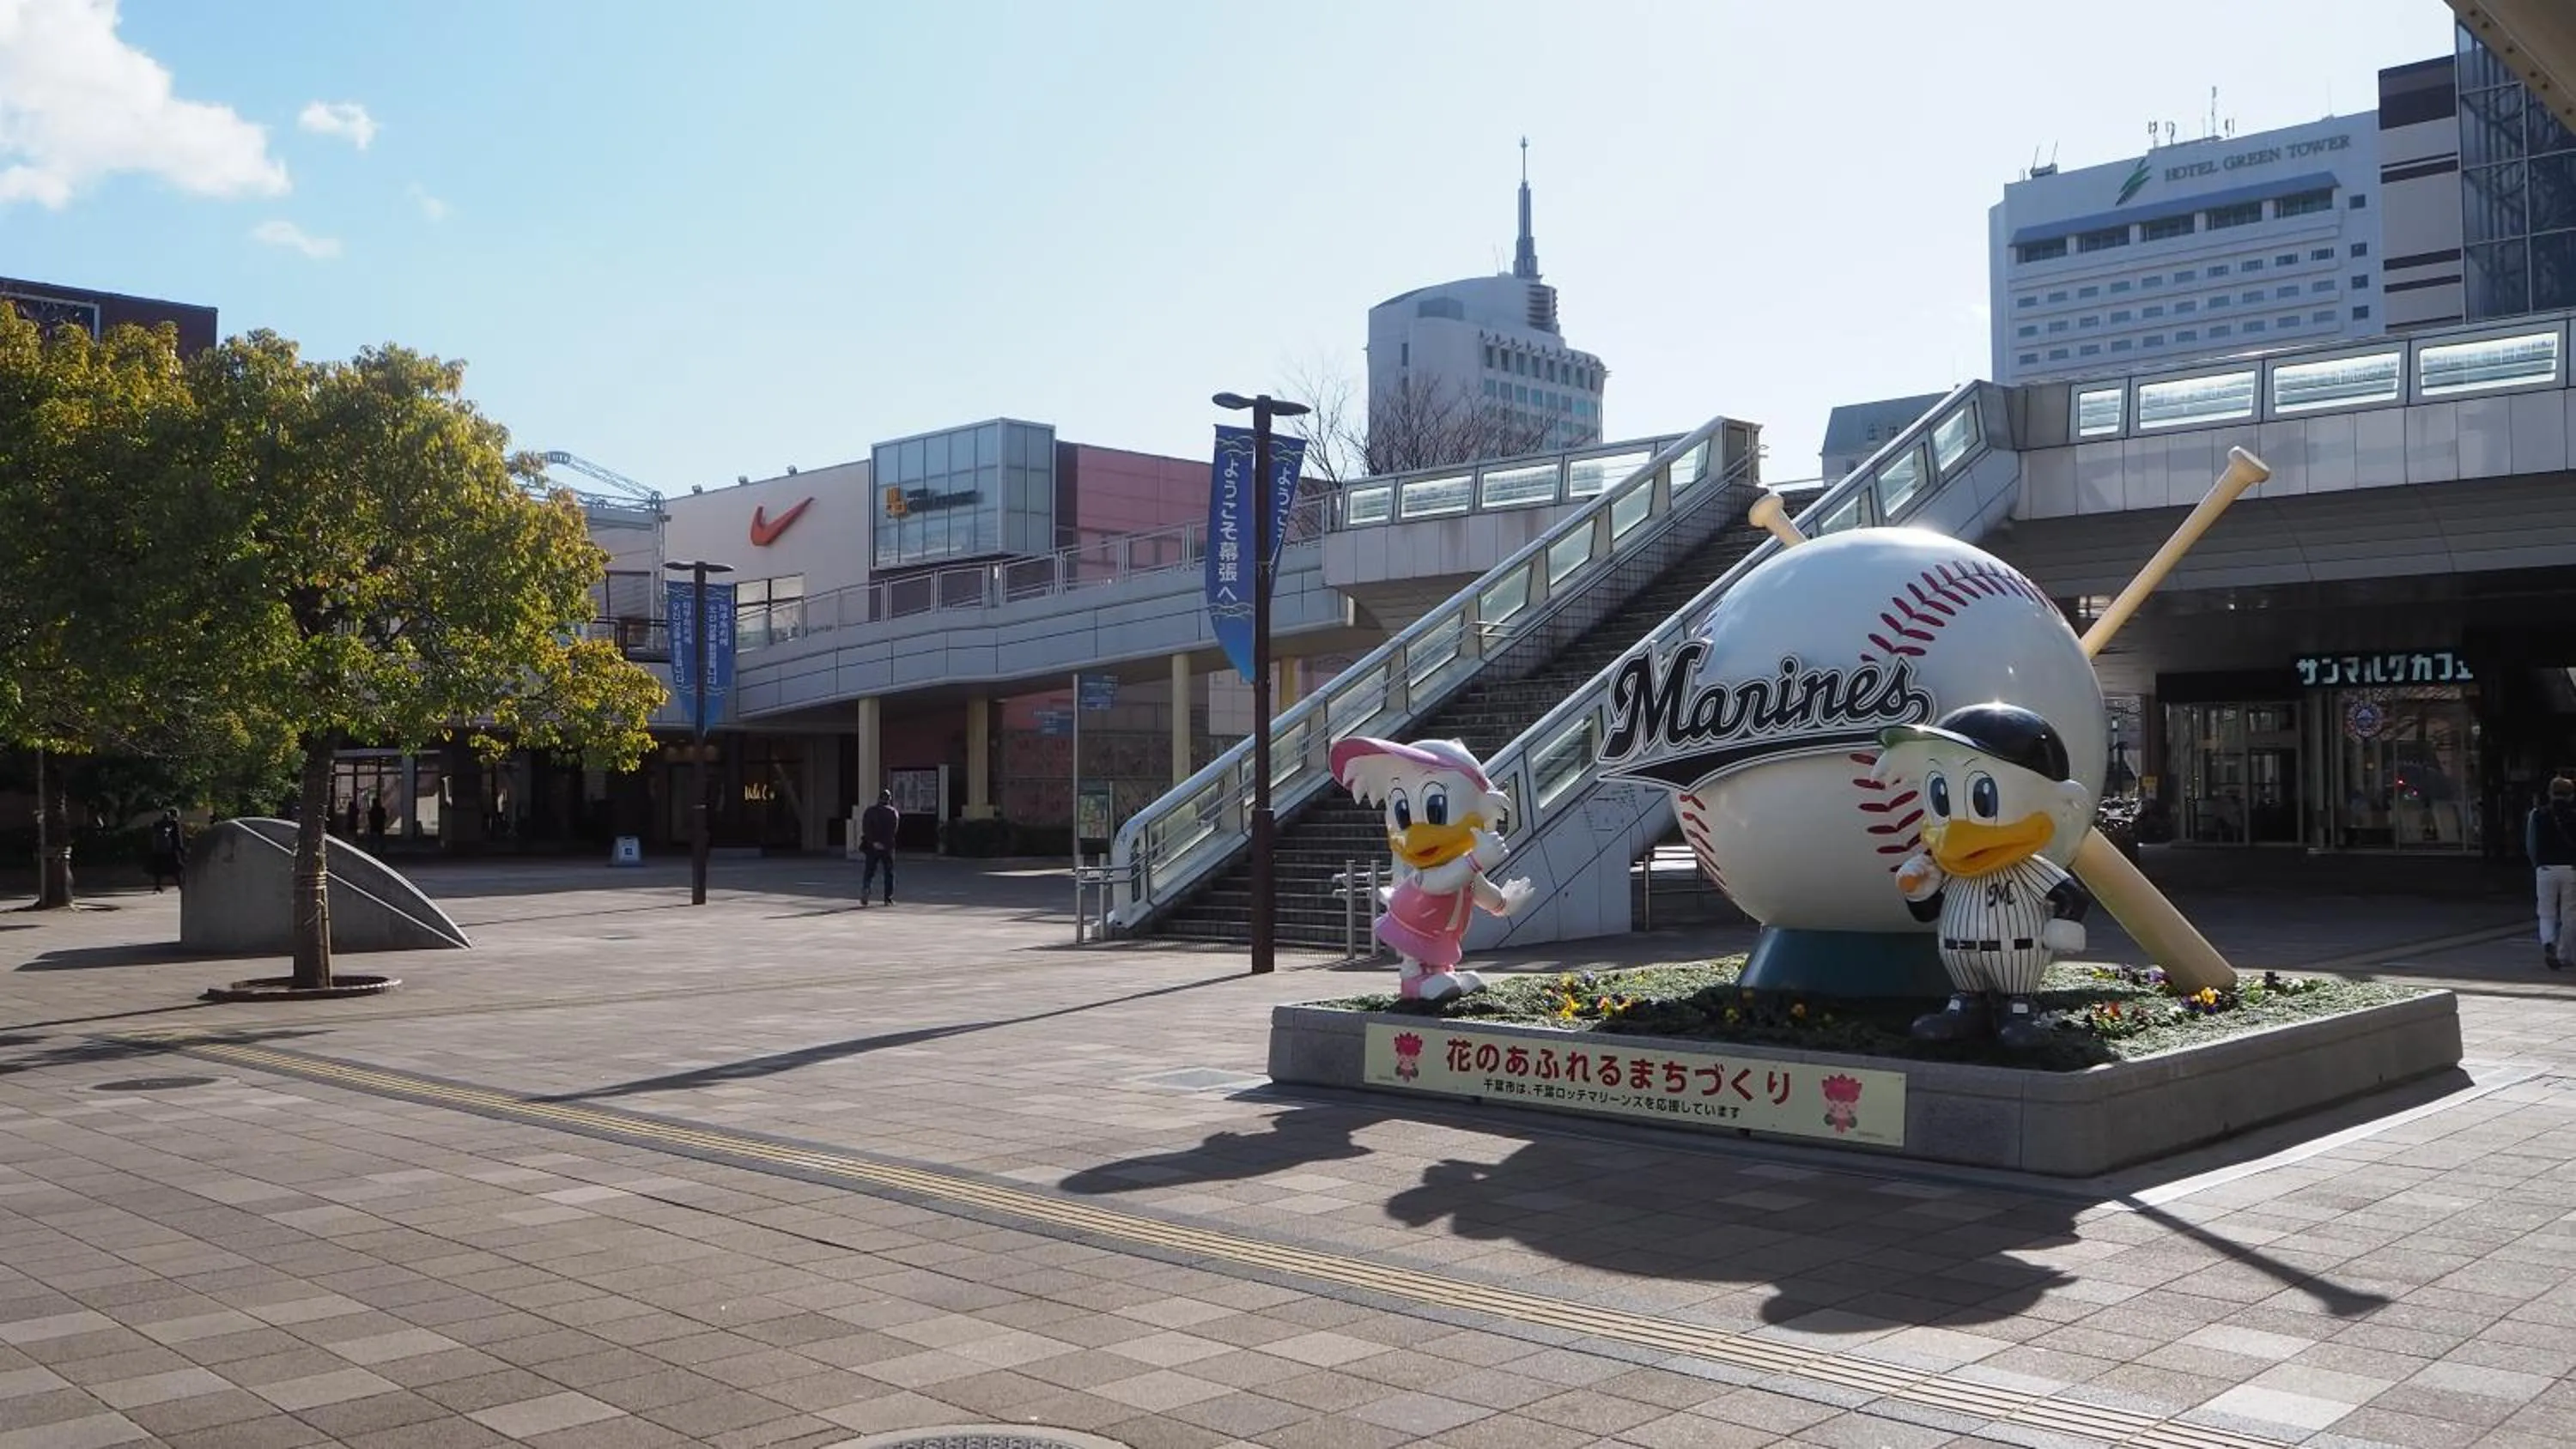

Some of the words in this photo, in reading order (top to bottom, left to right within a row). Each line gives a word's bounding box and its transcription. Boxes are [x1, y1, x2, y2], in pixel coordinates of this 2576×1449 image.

[2165, 160, 2219, 182] HOTEL
[2222, 147, 2281, 172] GREEN
[2286, 134, 2351, 159] TOWER
[1218, 457, 1240, 602] ようこそ幕張へ
[1597, 637, 1935, 764] Marines
[2296, 652, 2474, 685] サンマルクカフェ
[1446, 1037, 1792, 1106] 花のあふれるまちづくり
